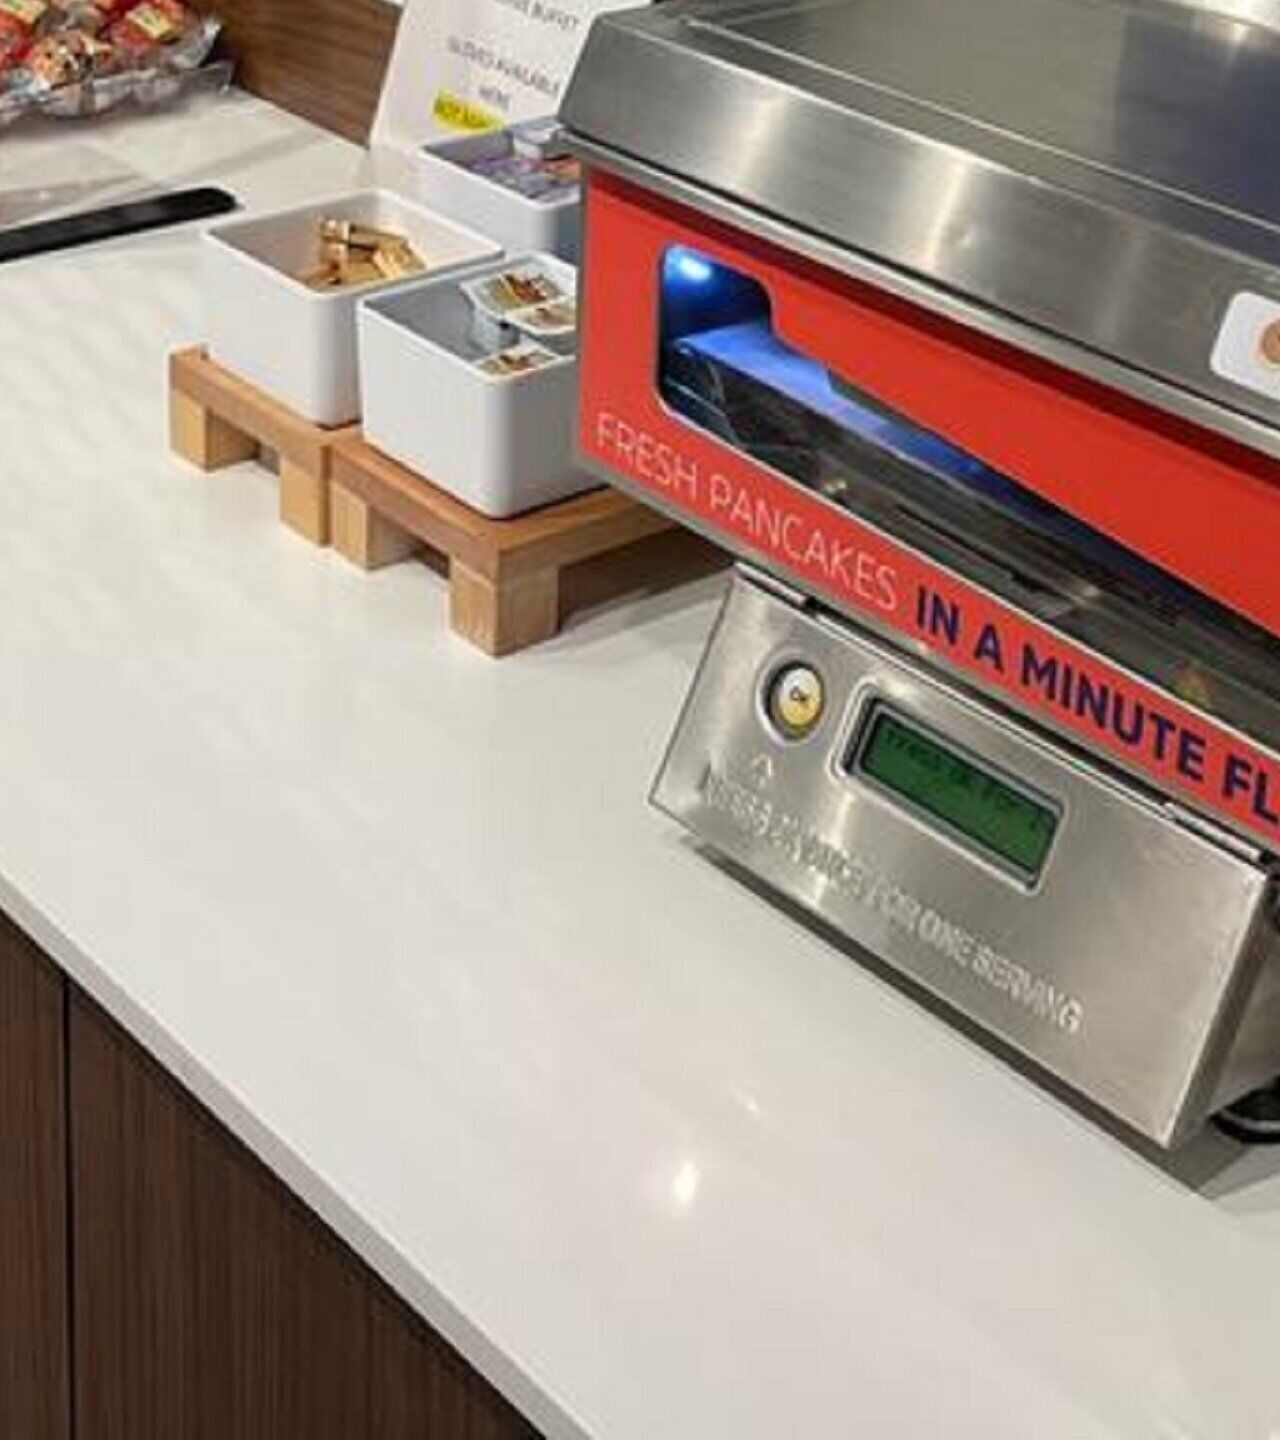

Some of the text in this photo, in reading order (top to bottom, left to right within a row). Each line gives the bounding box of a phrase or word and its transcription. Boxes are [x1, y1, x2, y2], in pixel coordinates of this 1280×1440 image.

[596, 412, 698, 501] FRESH
[709, 473, 897, 611] PANCAKES
[916, 584, 960, 646] IN
[973, 622, 1005, 672] A
[1021, 642, 1206, 784] MINUTE
